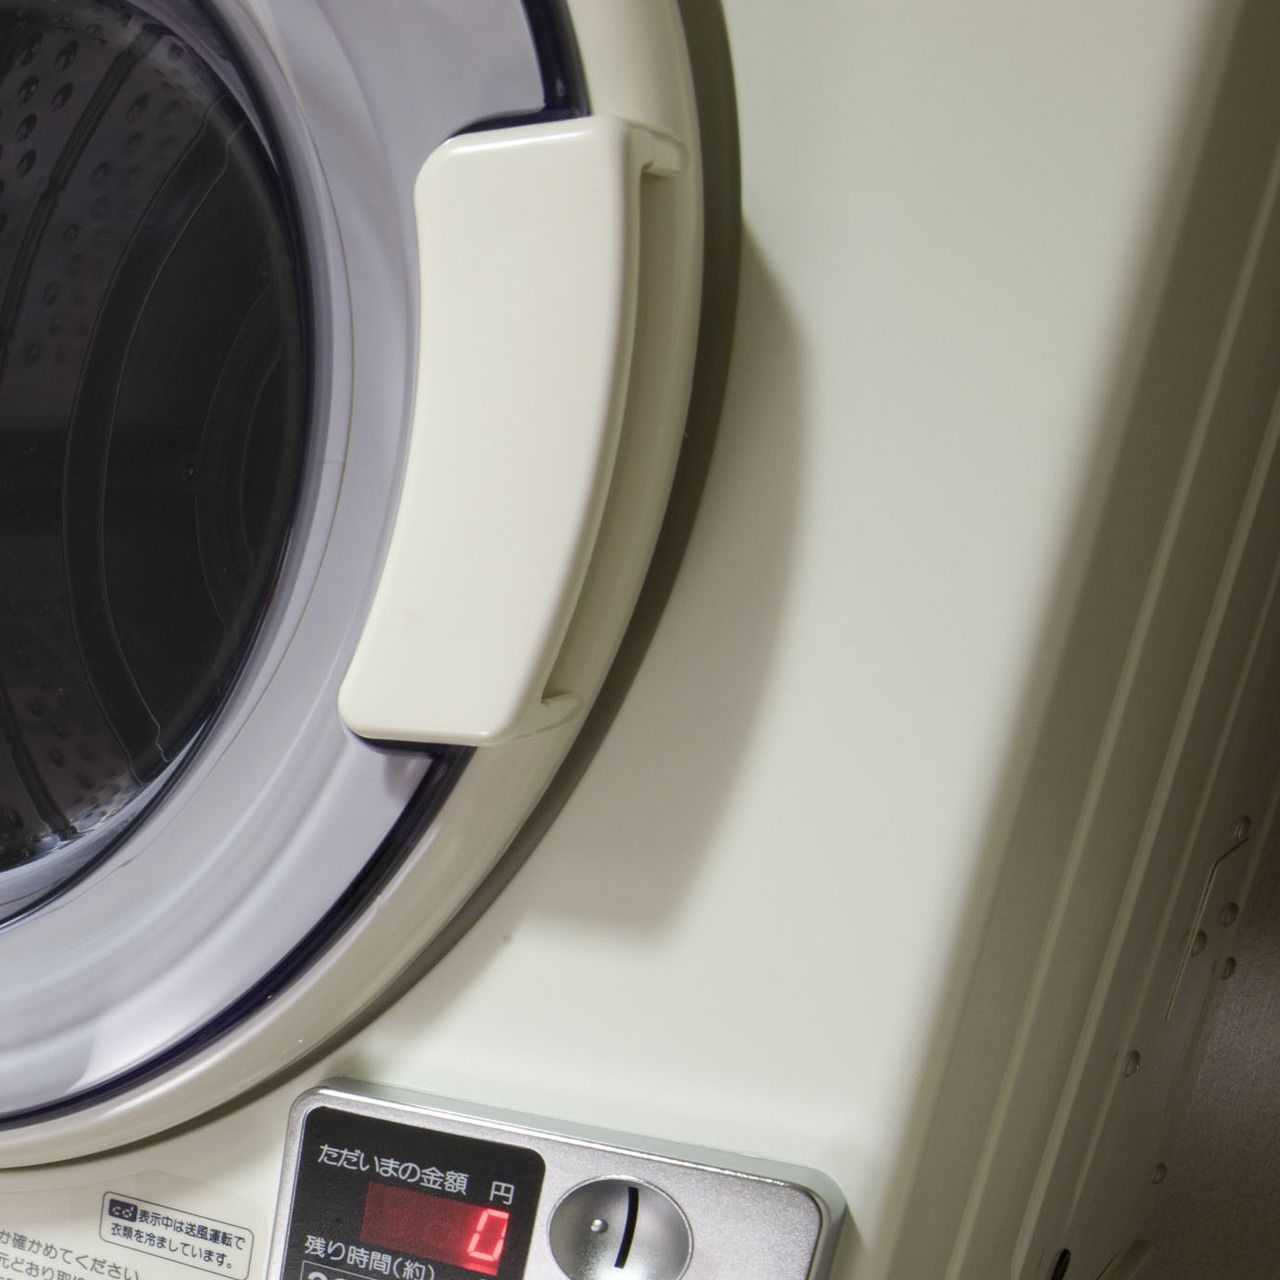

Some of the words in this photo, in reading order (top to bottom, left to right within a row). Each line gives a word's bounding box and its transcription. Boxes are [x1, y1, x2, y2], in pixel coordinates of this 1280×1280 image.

[317, 1143, 470, 1196] ただいまの金額
[489, 1180, 515, 1206] 円
[111, 1222, 232, 1269] 衣類を冷ましています。
[139, 1209, 246, 1250] 表示中は送風運転で
[467, 1207, 510, 1262] 0
